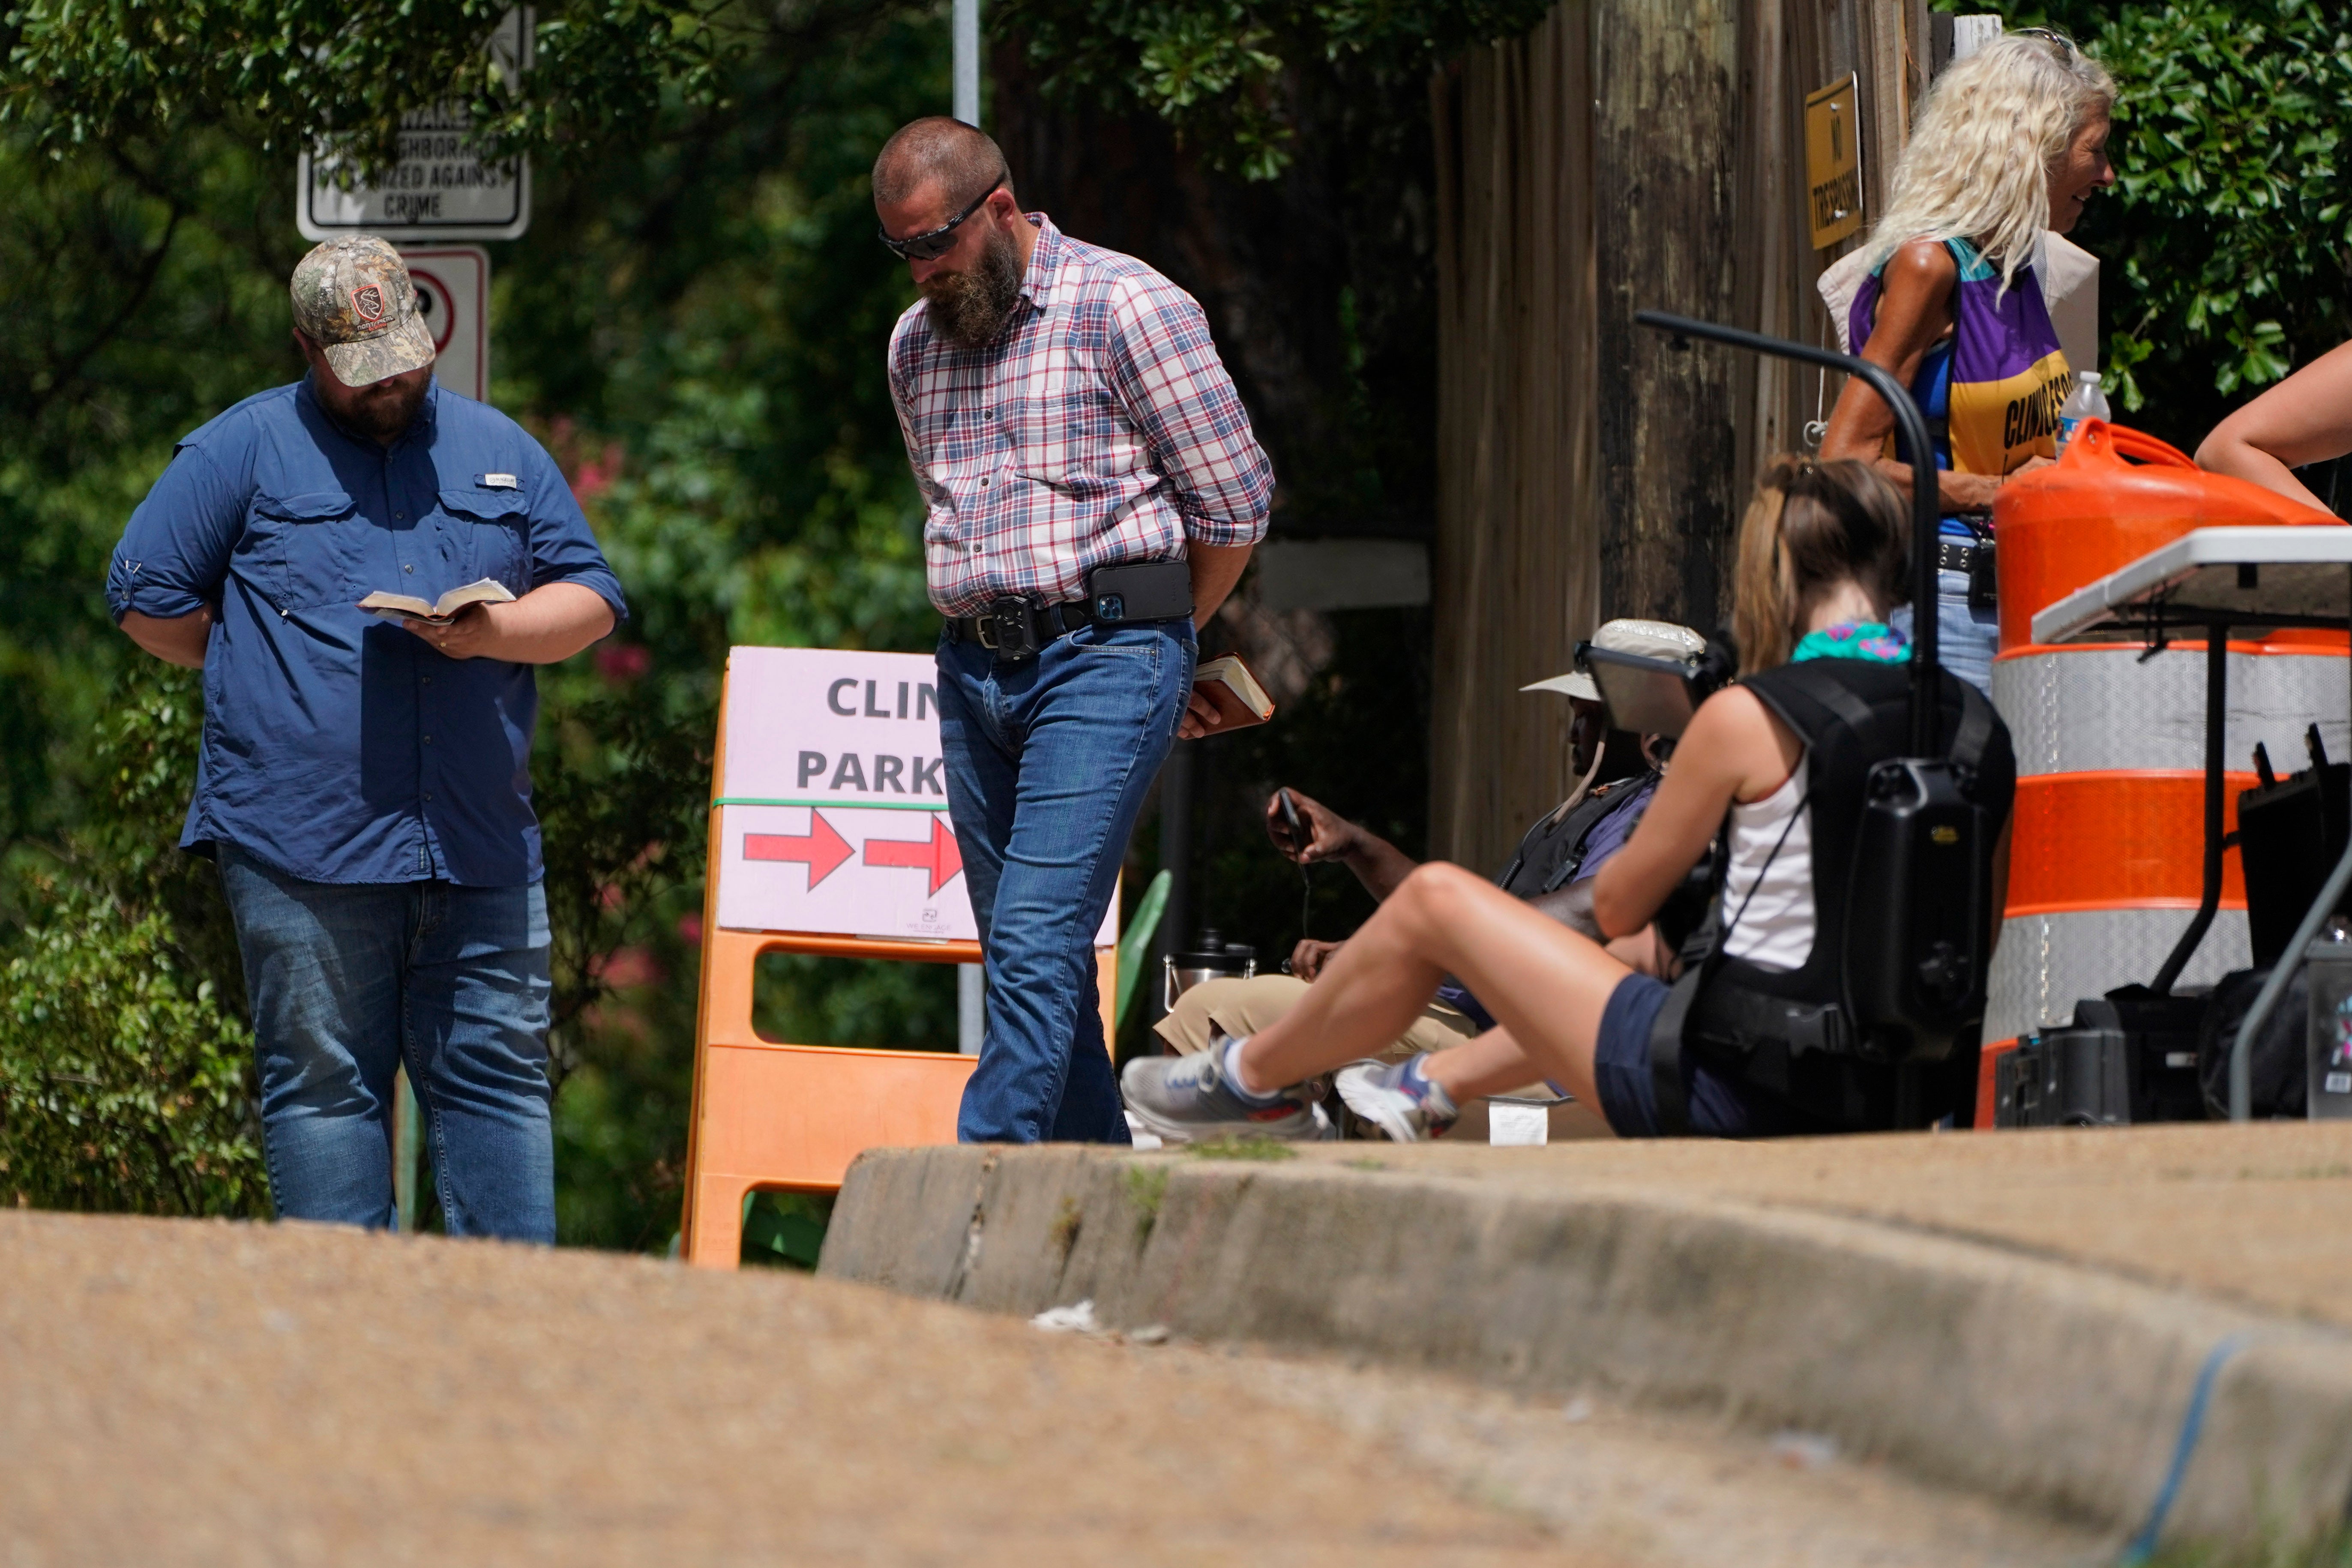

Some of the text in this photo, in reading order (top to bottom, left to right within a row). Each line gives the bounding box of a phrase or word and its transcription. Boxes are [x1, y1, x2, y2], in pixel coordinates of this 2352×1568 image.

[1831, 115, 1841, 161] NO
[384, 193, 440, 216] CRIME
[827, 678, 940, 721] CLIN
[797, 751, 944, 796] PARK
